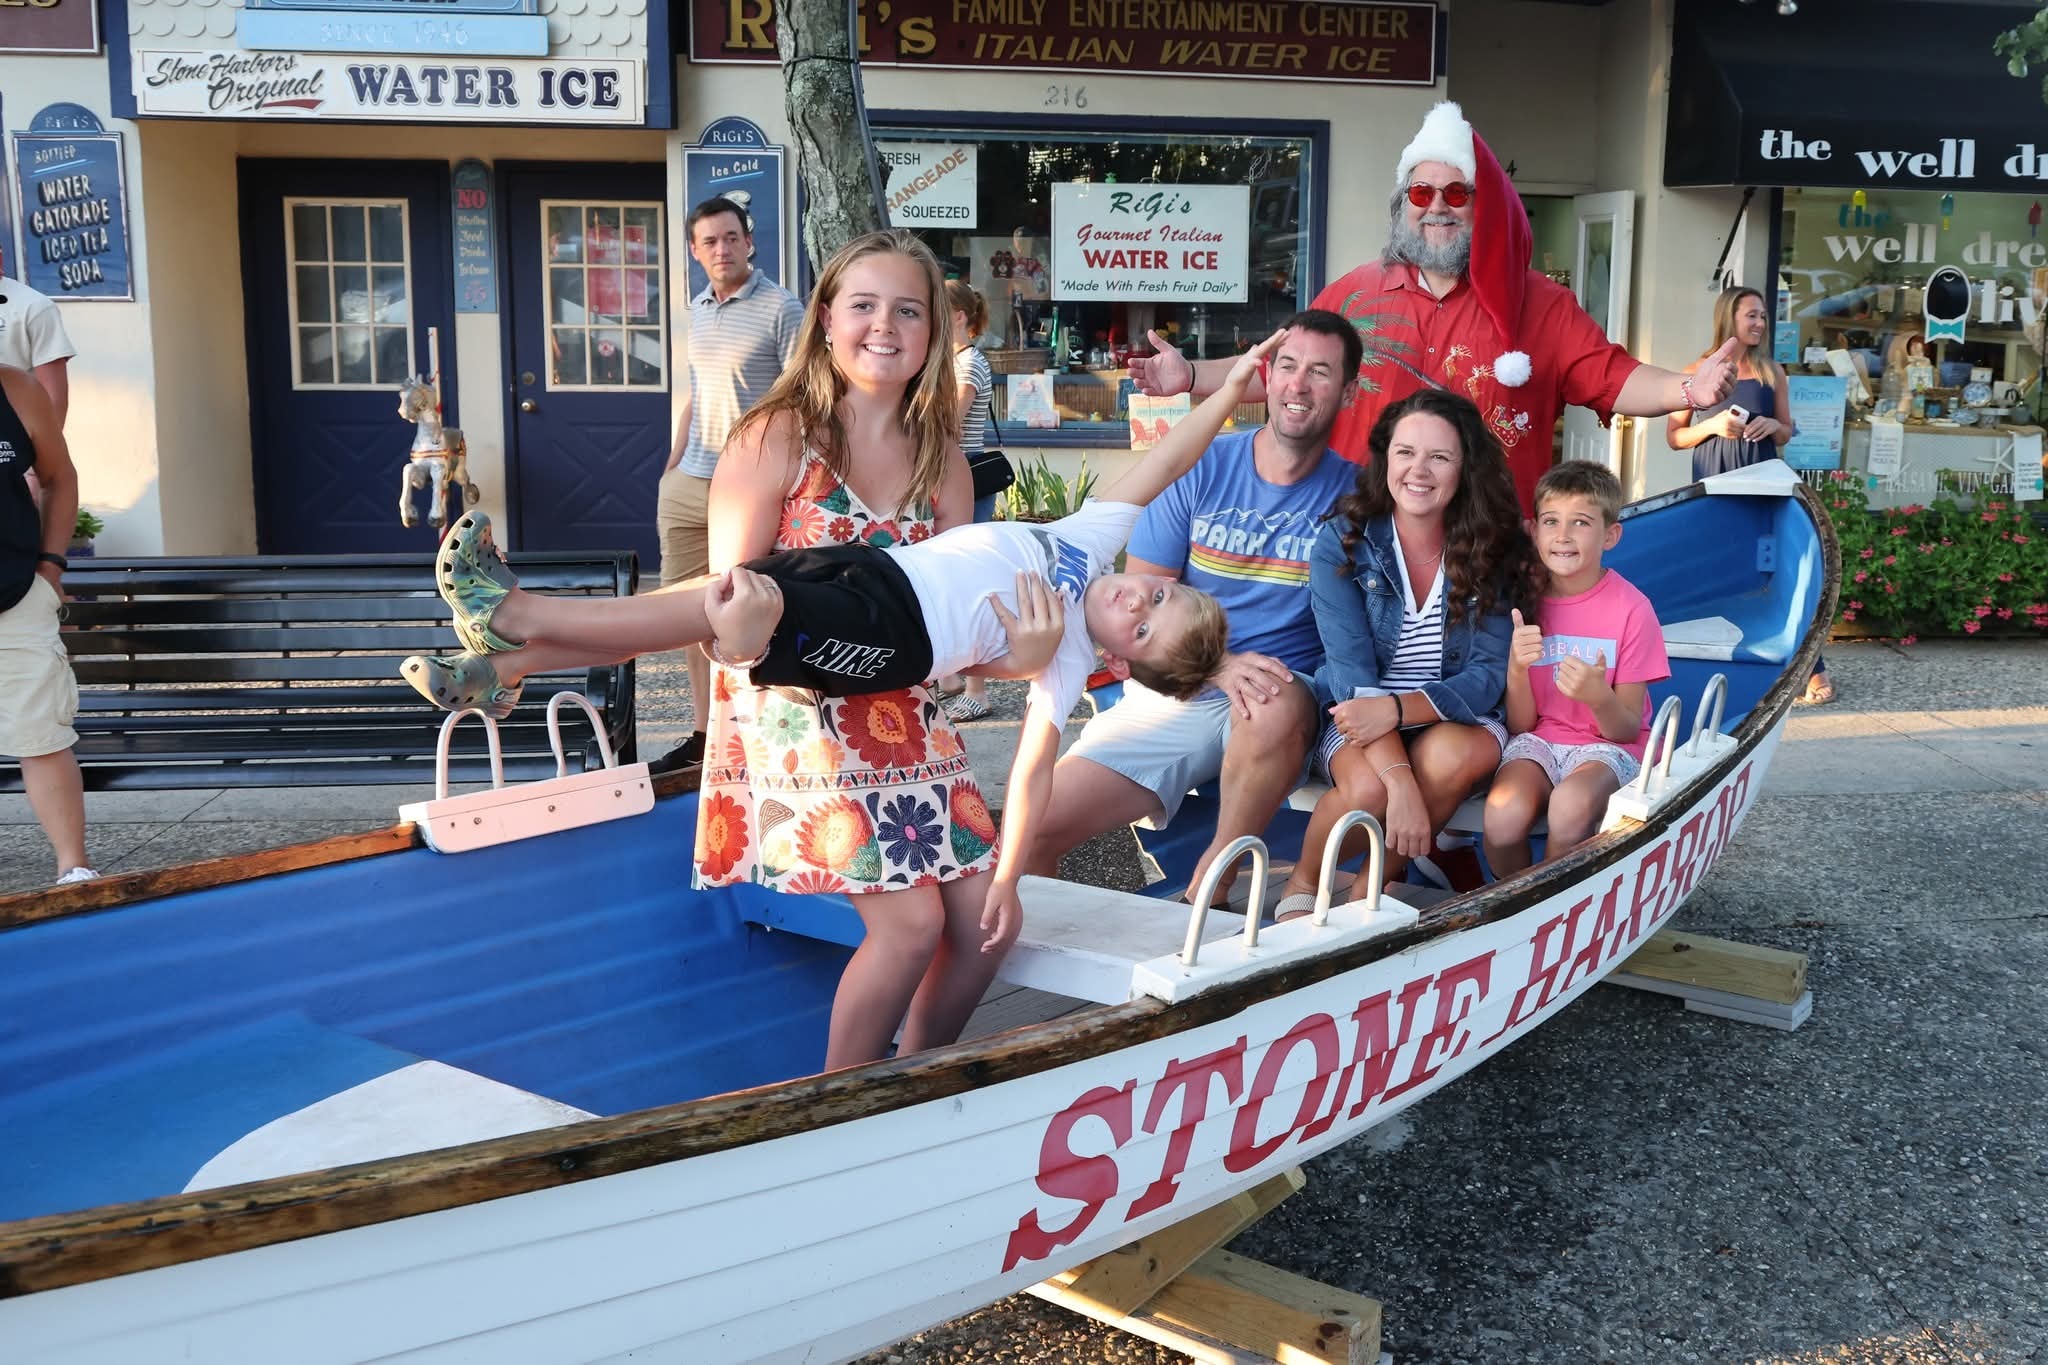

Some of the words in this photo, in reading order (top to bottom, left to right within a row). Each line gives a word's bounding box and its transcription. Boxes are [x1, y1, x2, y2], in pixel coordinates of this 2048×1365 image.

[410, 21, 471, 45] 1946
[952, 0, 1048, 26] FAMILY
[1069, 0, 1288, 33] ENTERTAINMENT
[1300, 3, 1409, 39] CENTER
[973, 33, 1135, 63] ITALIAN
[1160, 39, 1308, 70] WATER
[1326, 46, 1397, 73] ICE
[146, 57, 208, 87] Stone
[346, 64, 520, 106] WATER
[537, 67, 621, 109] ICE
[207, 69, 323, 110] Original
[1044, 85, 1088, 108] 216
[711, 165, 729, 177] Ice
[733, 160, 759, 173] Cold
[1760, 129, 1832, 160] the
[1854, 138, 1976, 178] well
[40, 174, 92, 204] WATER
[886, 148, 969, 213] RANGEADE
[456, 188, 487, 209] NO
[902, 205, 970, 219] SQUEEZED
[32, 198, 111, 234] GATORADE
[1839, 203, 1890, 229] the
[44, 234, 78, 260] ICED
[81, 227, 109, 252] TEA
[1077, 223, 1152, 246] Gourmet
[1159, 225, 1223, 242] Italian
[1823, 223, 1937, 263] well
[61, 258, 103, 287] SODA
[1082, 249, 1169, 269] WATER
[1183, 251, 1218, 270] ICE
[1061, 280, 1099, 291] "Made
[1106, 280, 1134, 291] With
[1137, 280, 1168, 292] Fresh
[1172, 281, 1198, 292] Fruit
[1203, 281, 1239, 295] Daily"
[1191, 519, 1268, 556] PARK
[1275, 534, 1317, 562] CIT
[802, 638, 896, 679] NIKE
[1001, 949, 1497, 1273] STONE
[1478, 760, 1754, 1049] HARBOR
